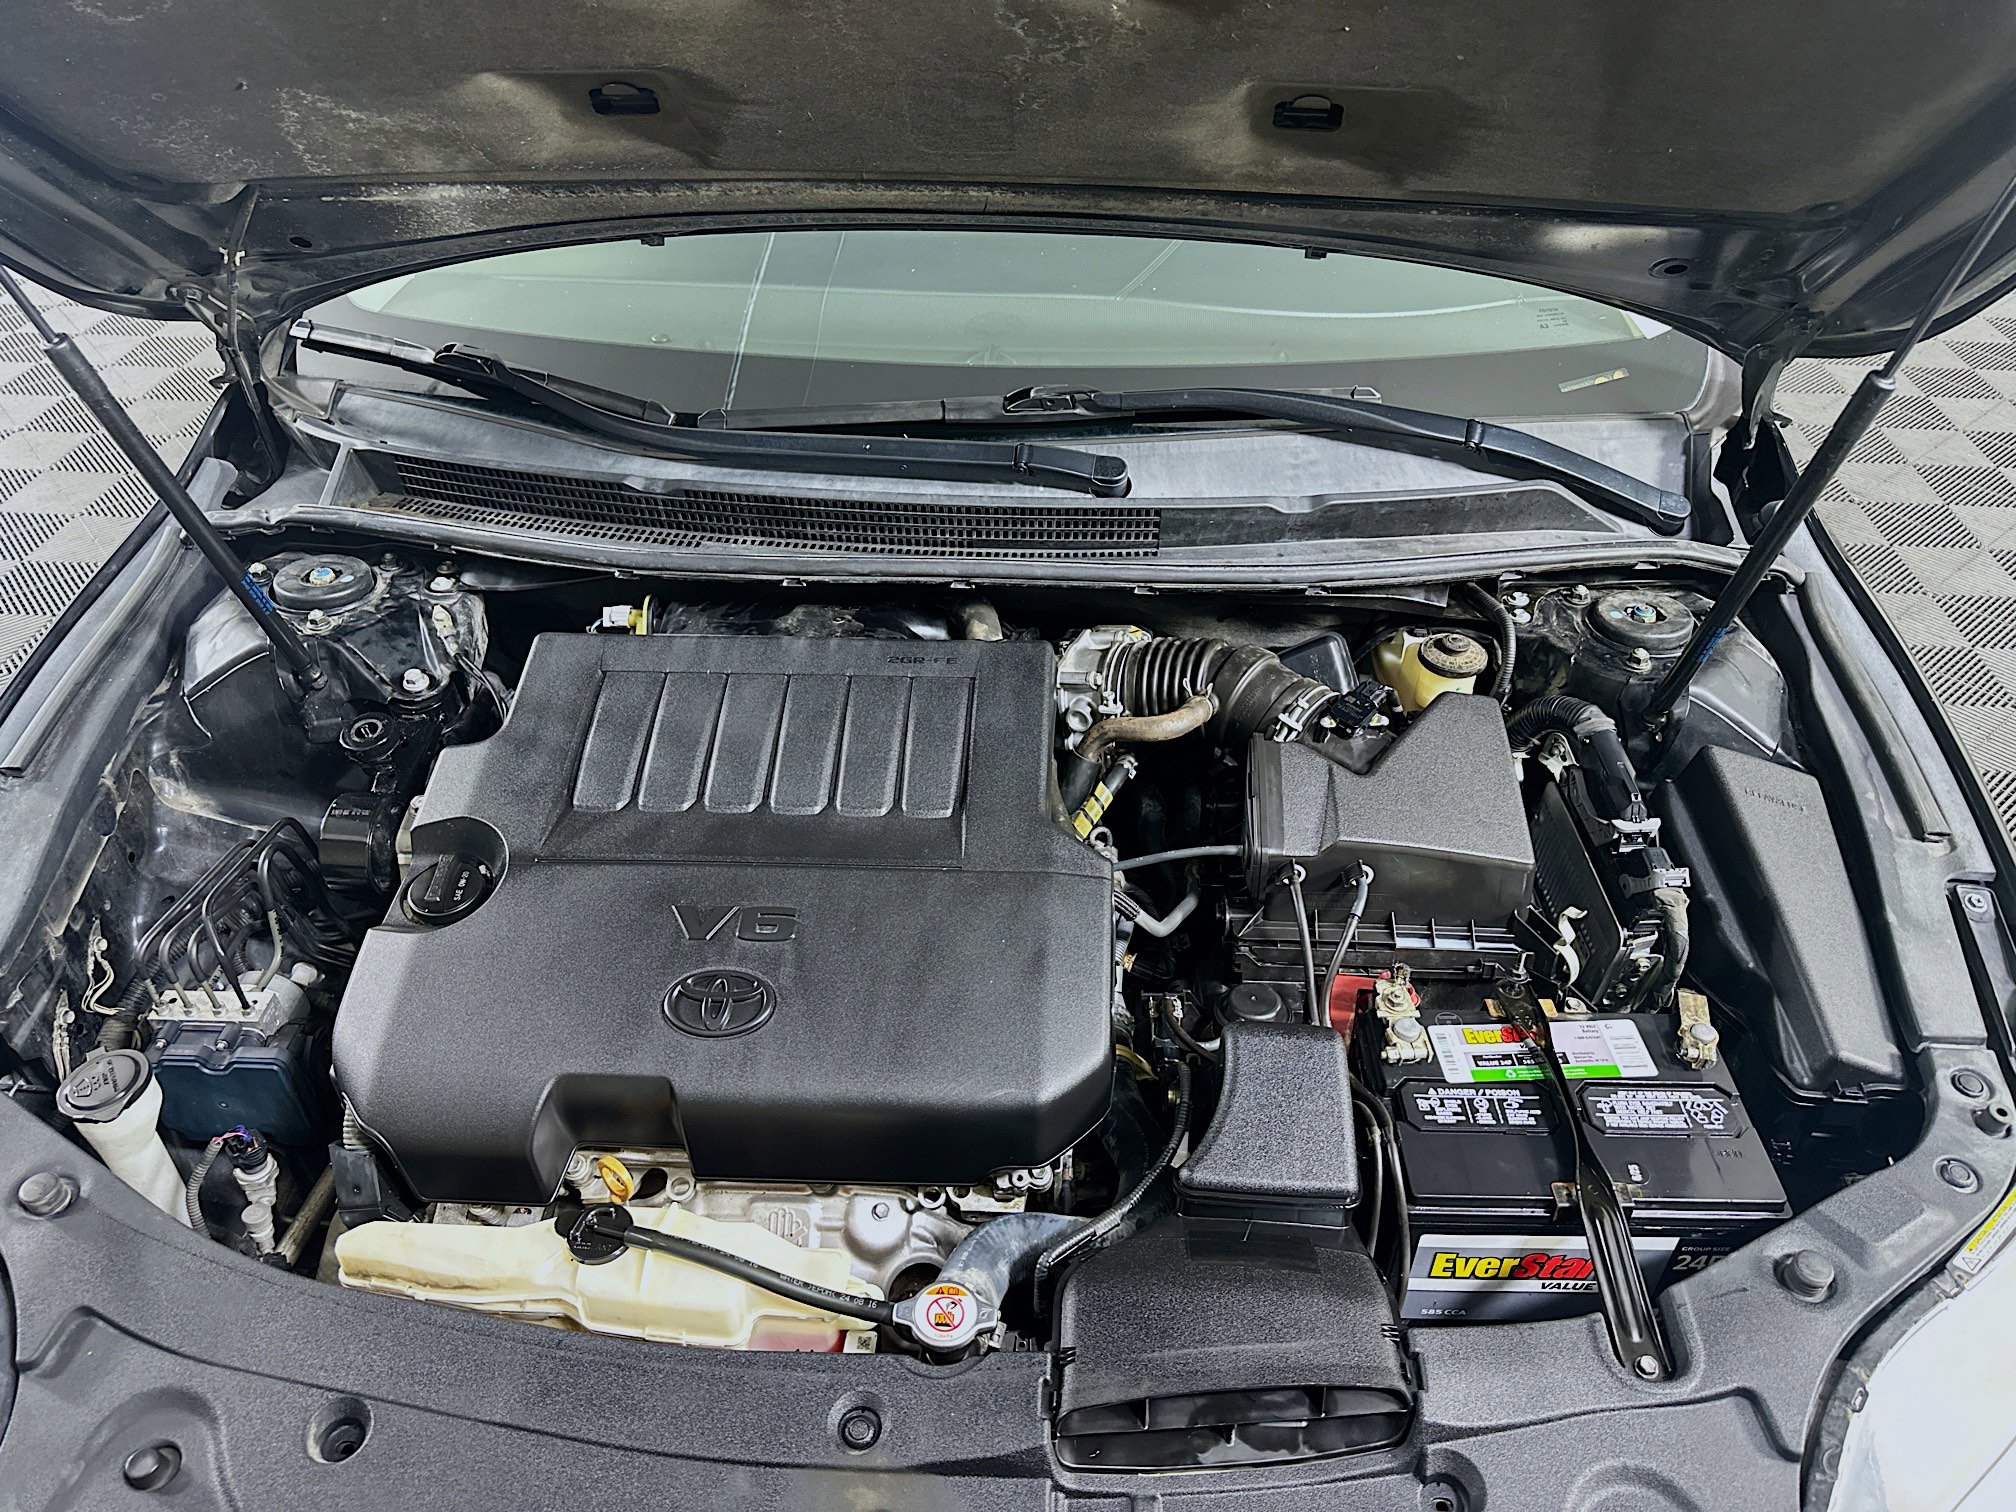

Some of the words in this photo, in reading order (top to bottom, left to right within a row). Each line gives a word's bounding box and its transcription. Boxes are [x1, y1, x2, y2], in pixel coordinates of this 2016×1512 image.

[453, 889, 464, 901] SAE
[671, 904, 799, 942] V6
[1437, 1088, 1477, 1096] DANGER
[1485, 1089, 1521, 1097] POISON
[780, 1273, 804, 1287] WATER
[840, 1294, 851, 1302] 24
[867, 1301, 878, 1309] 16
[1540, 1282, 1597, 1291] VALUE
[1420, 1308, 1443, 1316] 585
[1443, 1308, 1468, 1316] CCA
